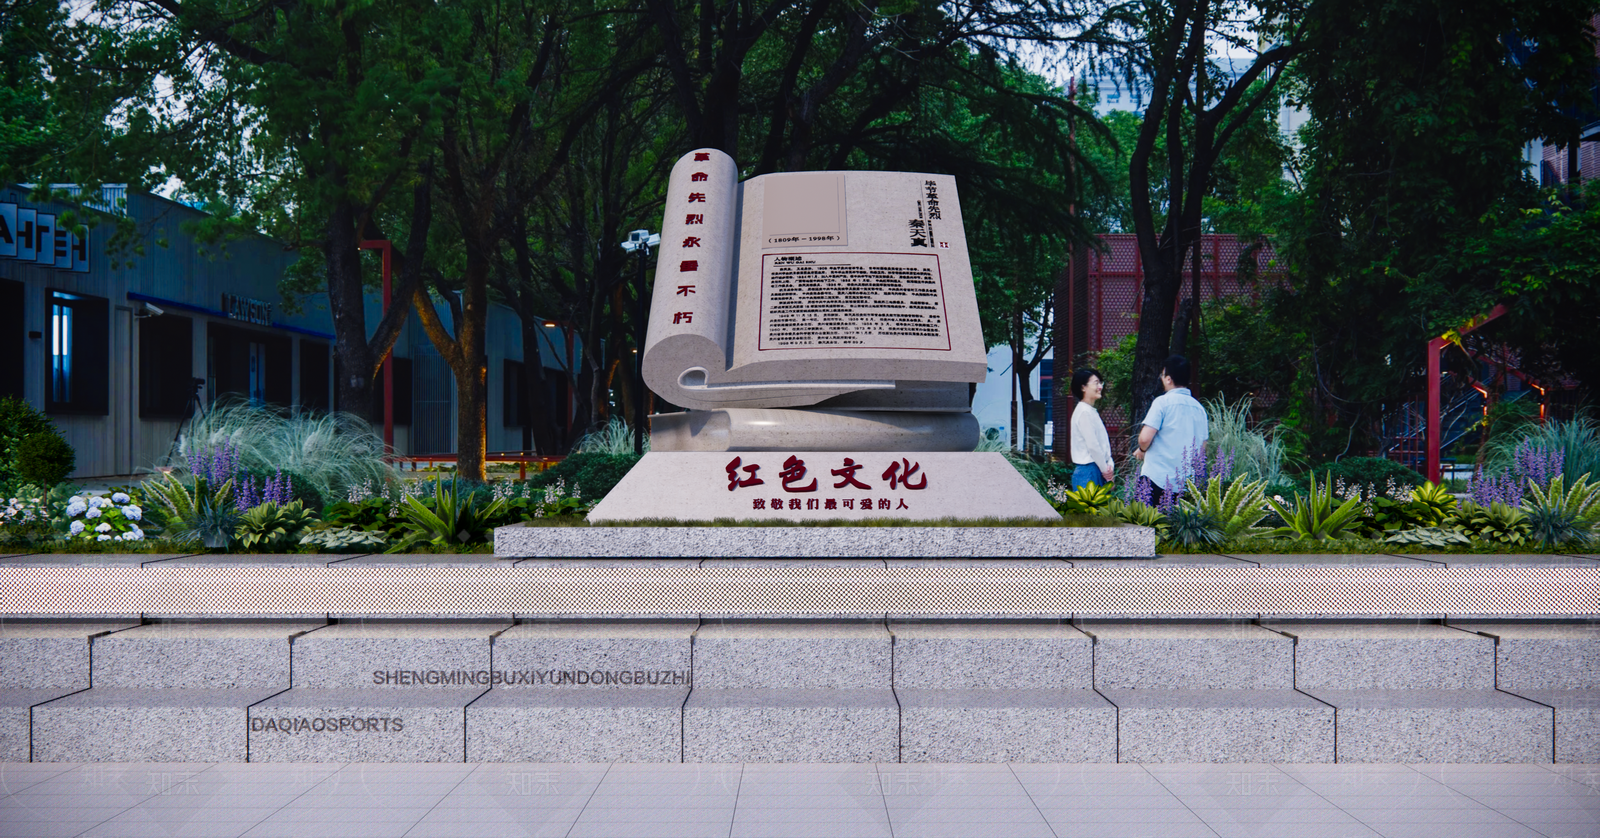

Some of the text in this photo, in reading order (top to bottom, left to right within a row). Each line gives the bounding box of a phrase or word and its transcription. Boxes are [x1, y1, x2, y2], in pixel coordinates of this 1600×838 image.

[925, 180, 941, 220] 毕节革命先烈
[672, 152, 710, 325] 革命先烈永垂不朽
[725, 454, 927, 493] 红色文化
[753, 498, 909, 510] 致敬我们最可爱的人
[251, 717, 404, 734] DAQIAOSPORTS
